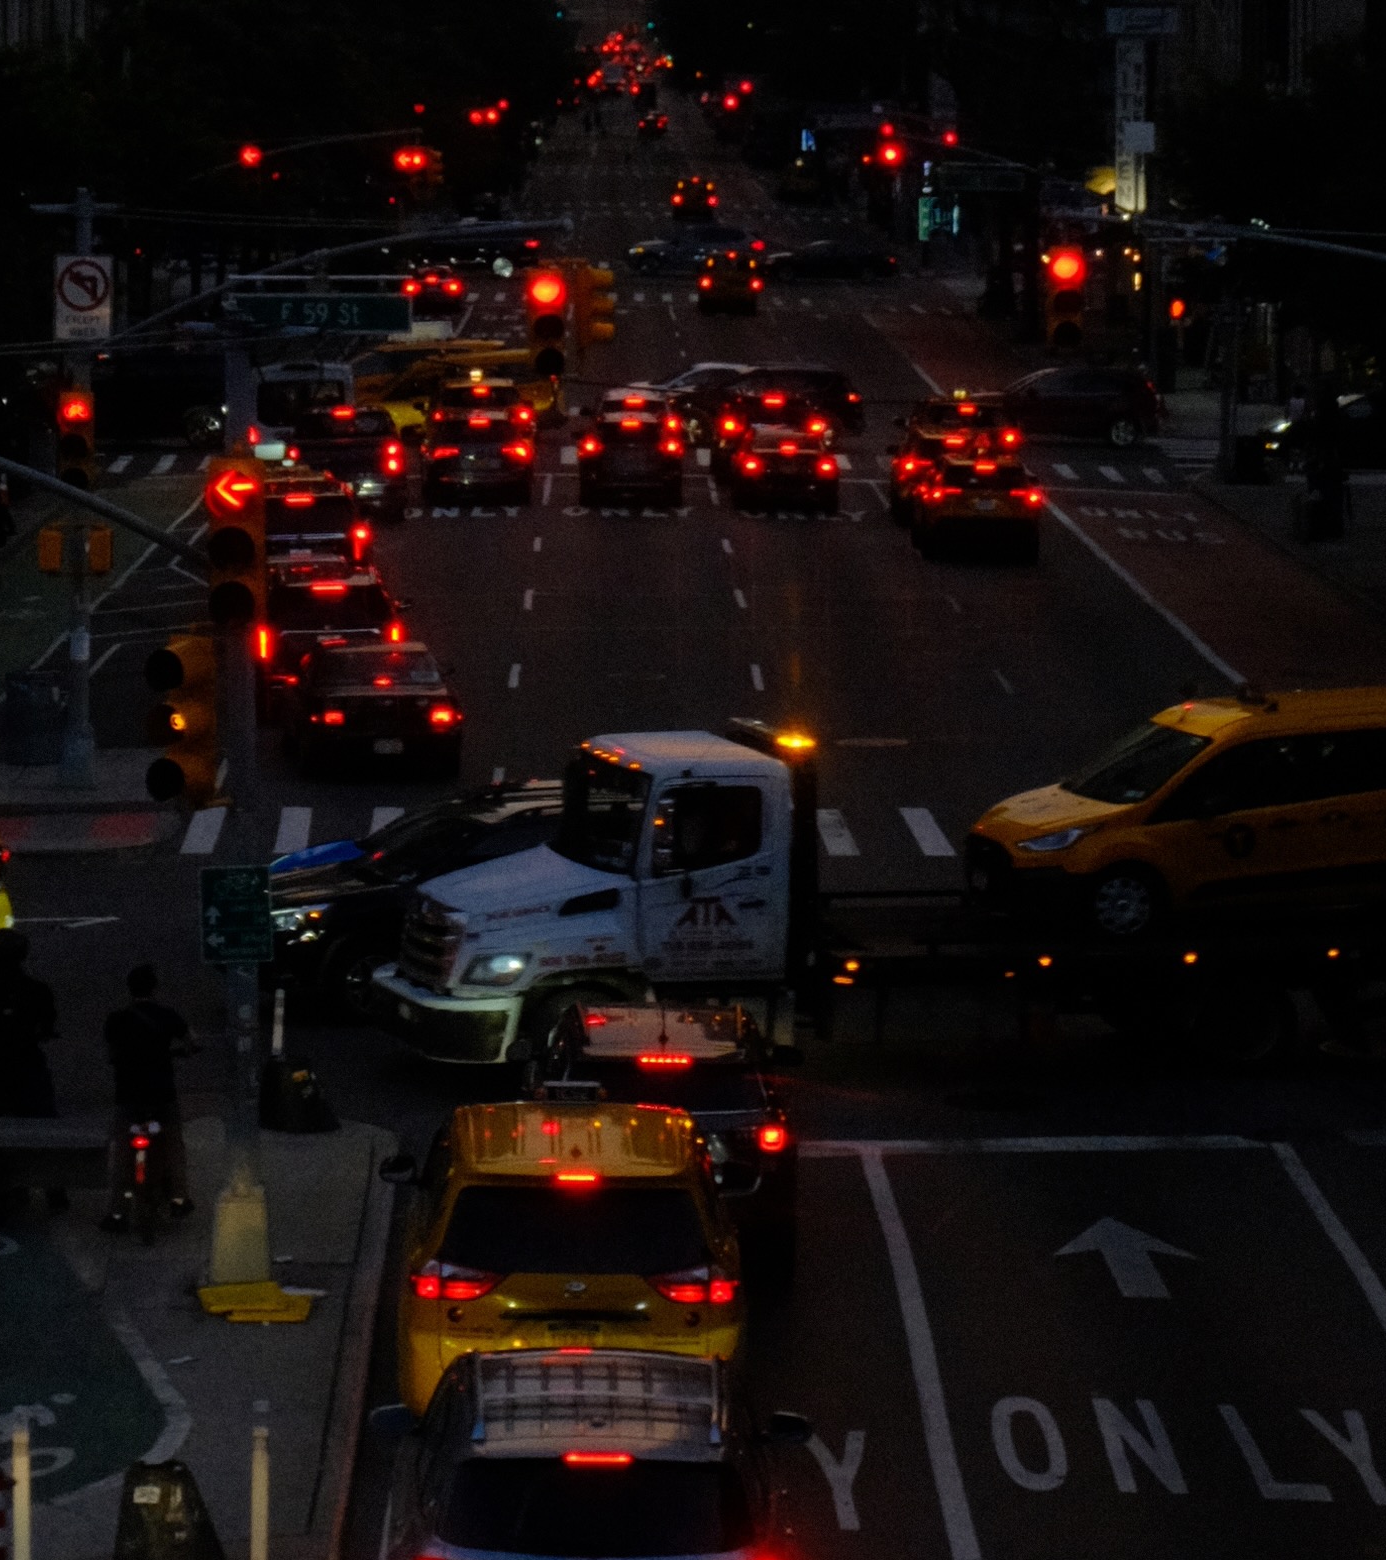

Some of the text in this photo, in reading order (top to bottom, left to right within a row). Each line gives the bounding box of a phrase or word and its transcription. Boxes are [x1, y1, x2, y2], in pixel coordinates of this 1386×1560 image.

[303, 303, 329, 325] 59
[338, 303, 360, 325] St
[676, 897, 737, 927] ATA
